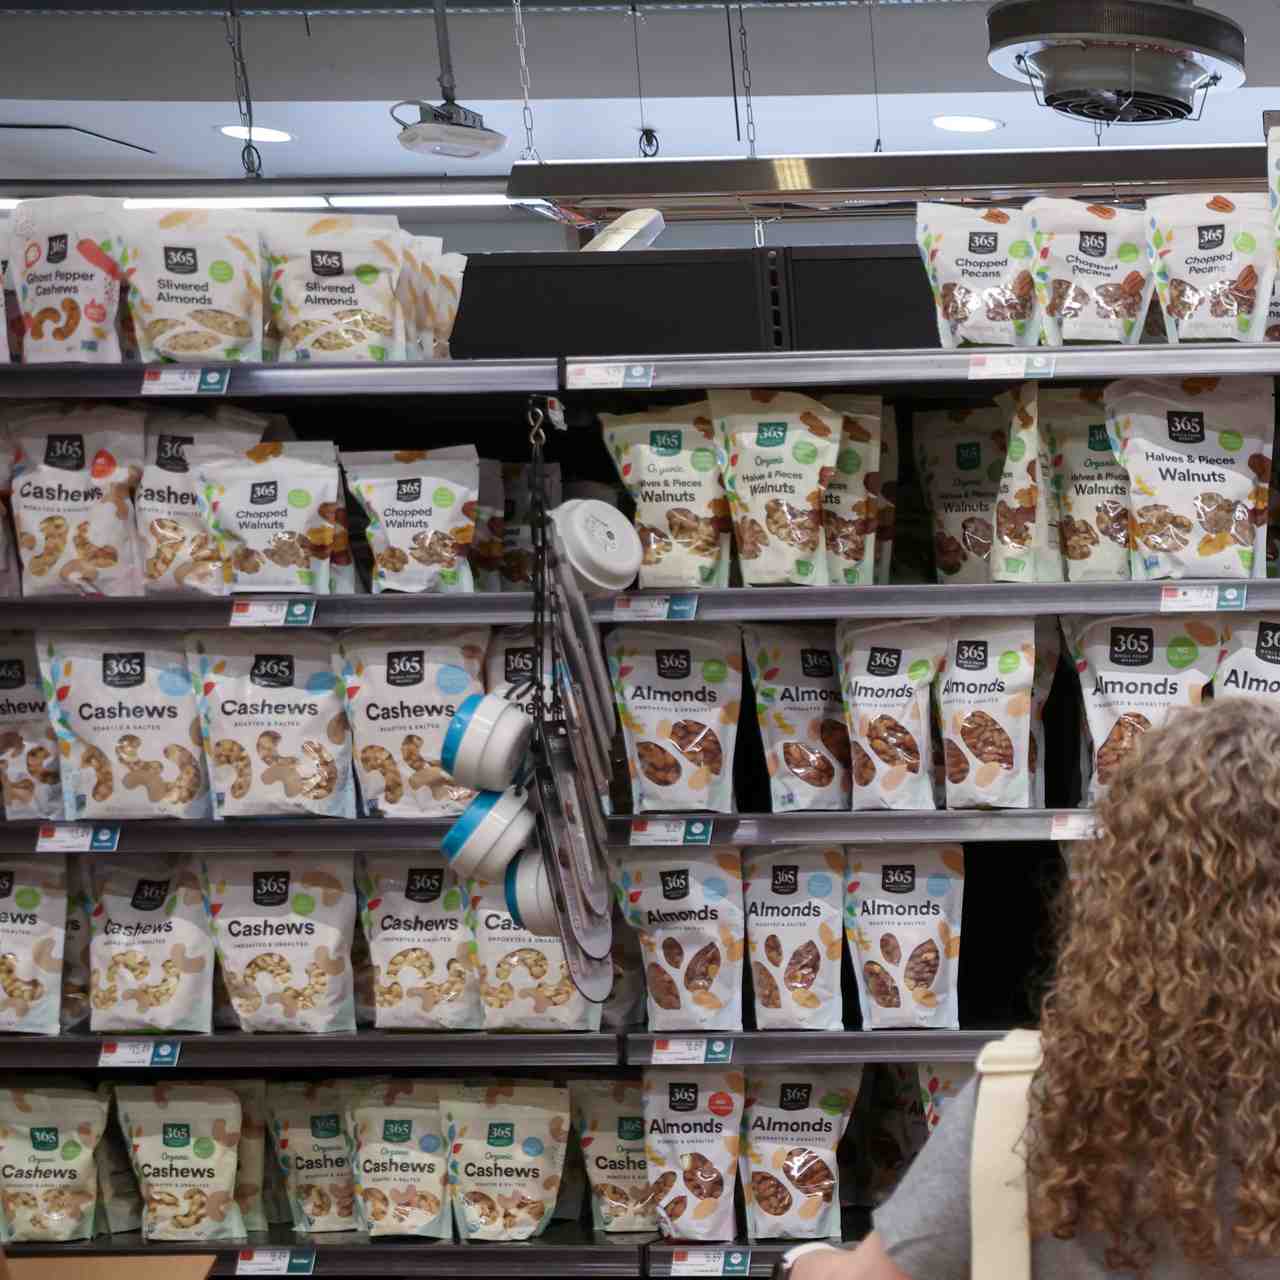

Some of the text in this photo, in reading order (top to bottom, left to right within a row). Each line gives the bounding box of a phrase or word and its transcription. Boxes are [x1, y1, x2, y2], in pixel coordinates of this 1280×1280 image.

[971, 234, 996, 248] 365
[955, 258, 1008, 272] Chopped
[961, 268, 1001, 278] Pecans
[157, 294, 212, 306] Almonds
[1114, 633, 1148, 652] 365
[108, 656, 142, 675] 365
[1094, 676, 1178, 695] Almonds
[632, 686, 716, 702] Almonds
[78, 702, 178, 720] Cashews
[221, 699, 318, 716] Cashews
[860, 900, 940, 917] Almonds
[228, 920, 314, 938] Cashews
[650, 1119, 722, 1134] Almonds
[464, 1163, 540, 1178] Cashews
